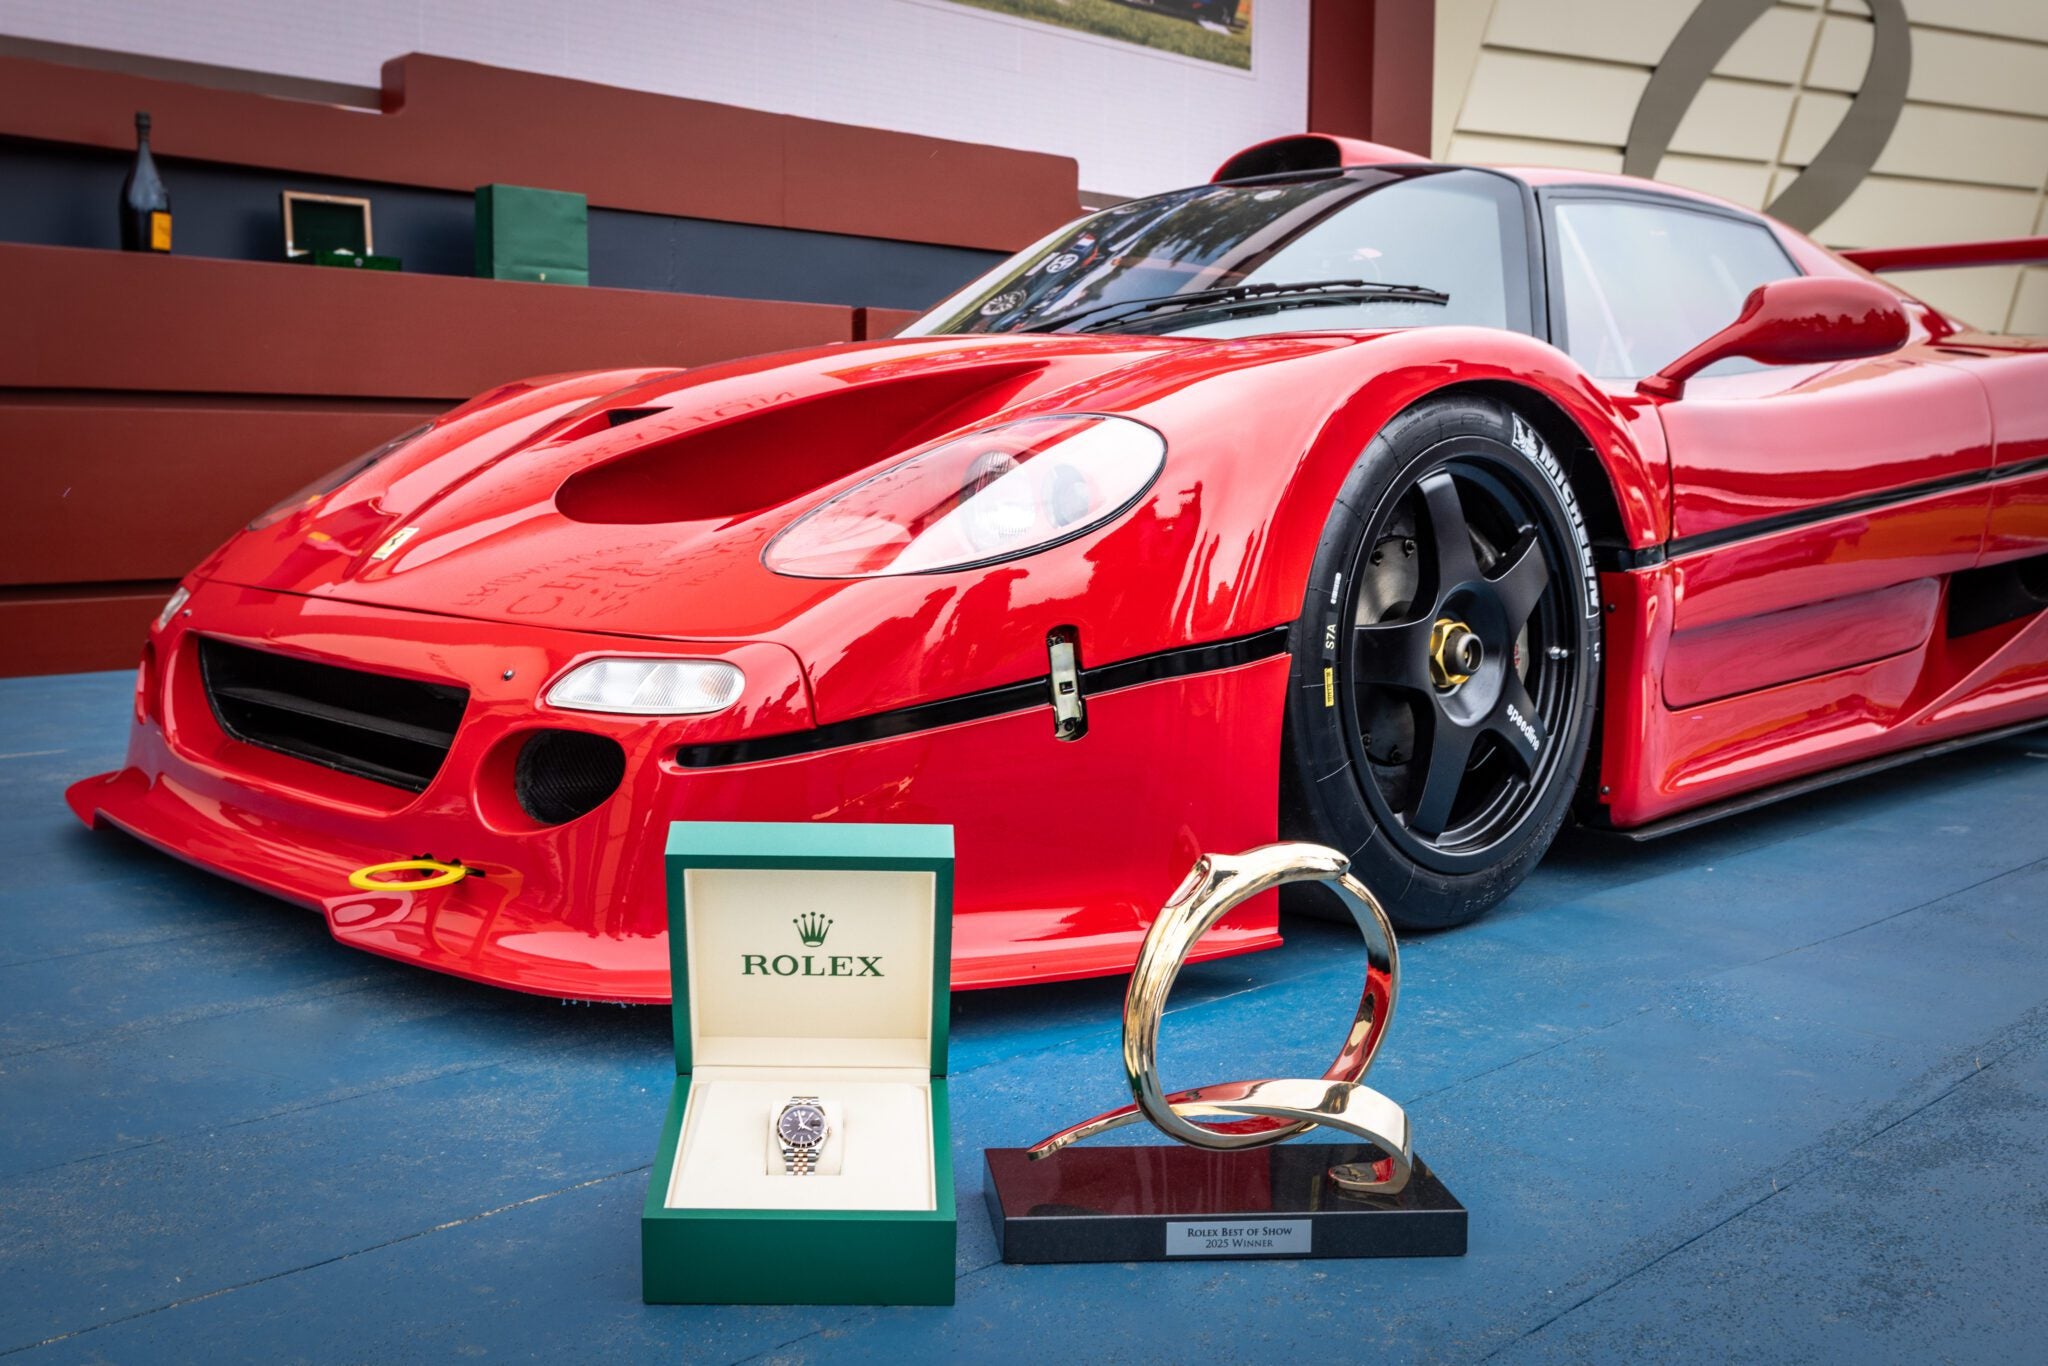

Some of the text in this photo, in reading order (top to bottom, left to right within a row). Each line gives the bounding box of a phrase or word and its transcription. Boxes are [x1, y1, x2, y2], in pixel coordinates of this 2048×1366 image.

[1539, 444, 1599, 607] MICHELIN
[1325, 624, 1336, 650] S7A
[1507, 704, 1540, 751] speedline
[741, 954, 885, 977] ROLEX
[1205, 1238, 1274, 1249] 2025 WINNER
